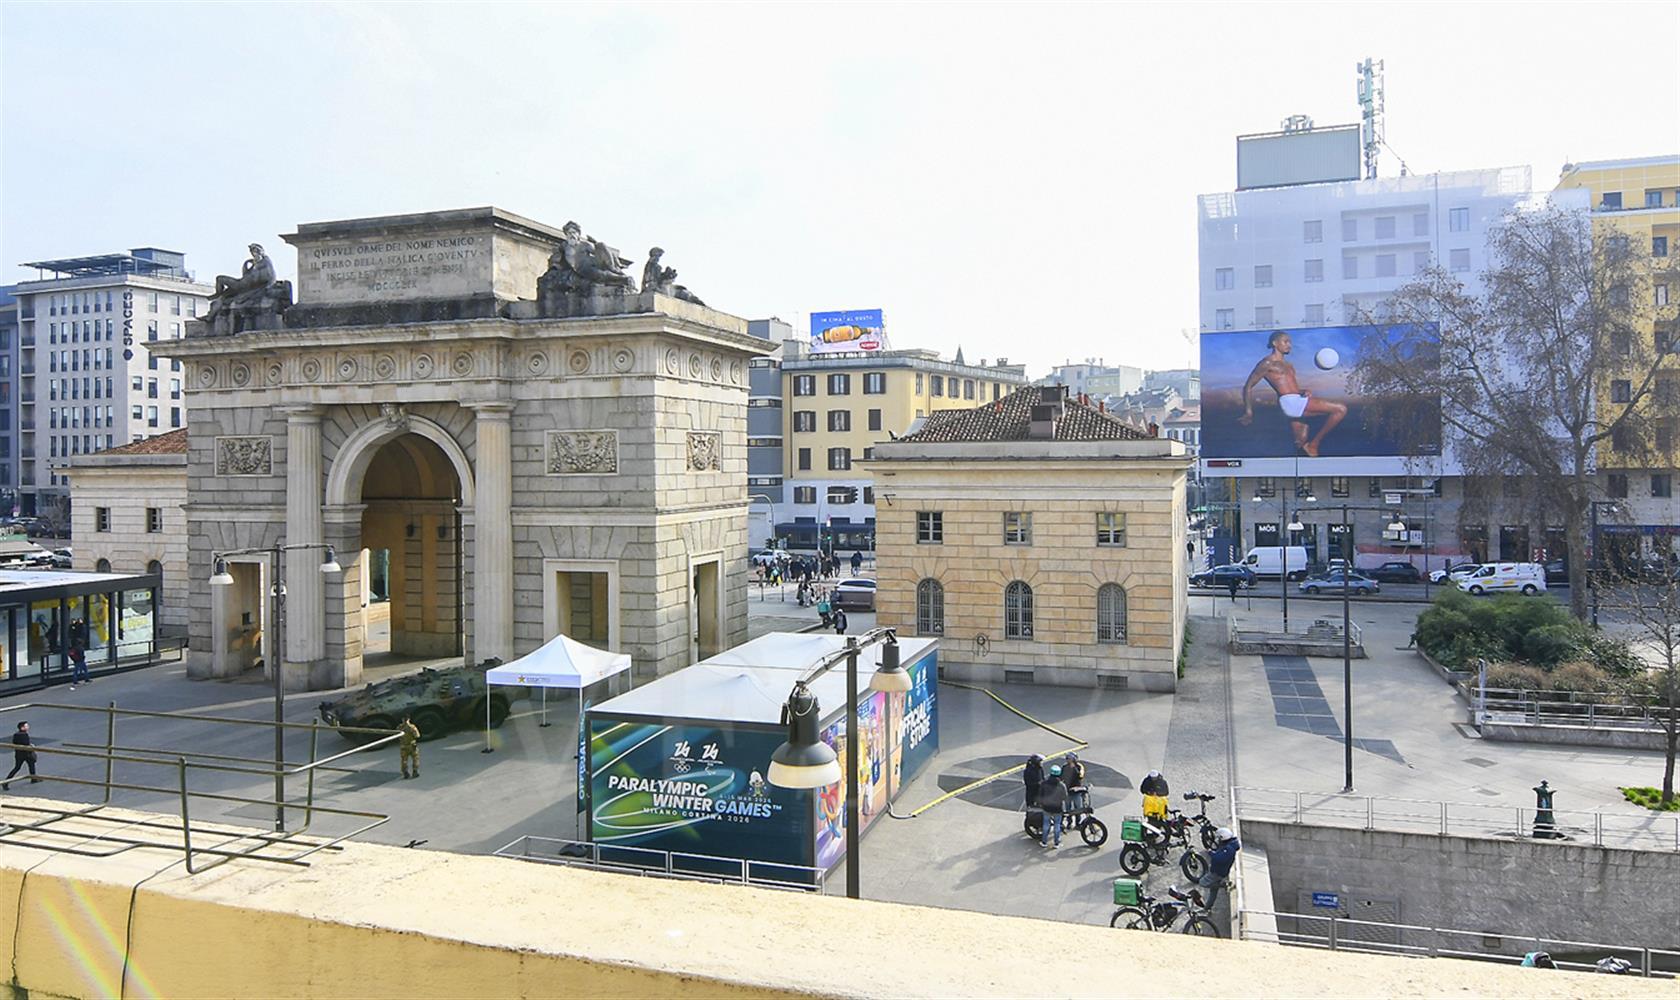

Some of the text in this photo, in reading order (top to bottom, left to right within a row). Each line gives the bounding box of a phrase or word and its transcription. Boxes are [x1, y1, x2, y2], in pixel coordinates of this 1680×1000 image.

[356, 244, 384, 254] ORME
[406, 240, 435, 250] NOME
[436, 236, 475, 248] NEMICO
[321, 259, 352, 269] FERRO
[354, 256, 384, 267] DELLA
[608, 775, 708, 797] PARALYMPIC
[652, 793, 712, 812] WINTER
[642, 807, 750, 824] MILANO CORTINA 2026
